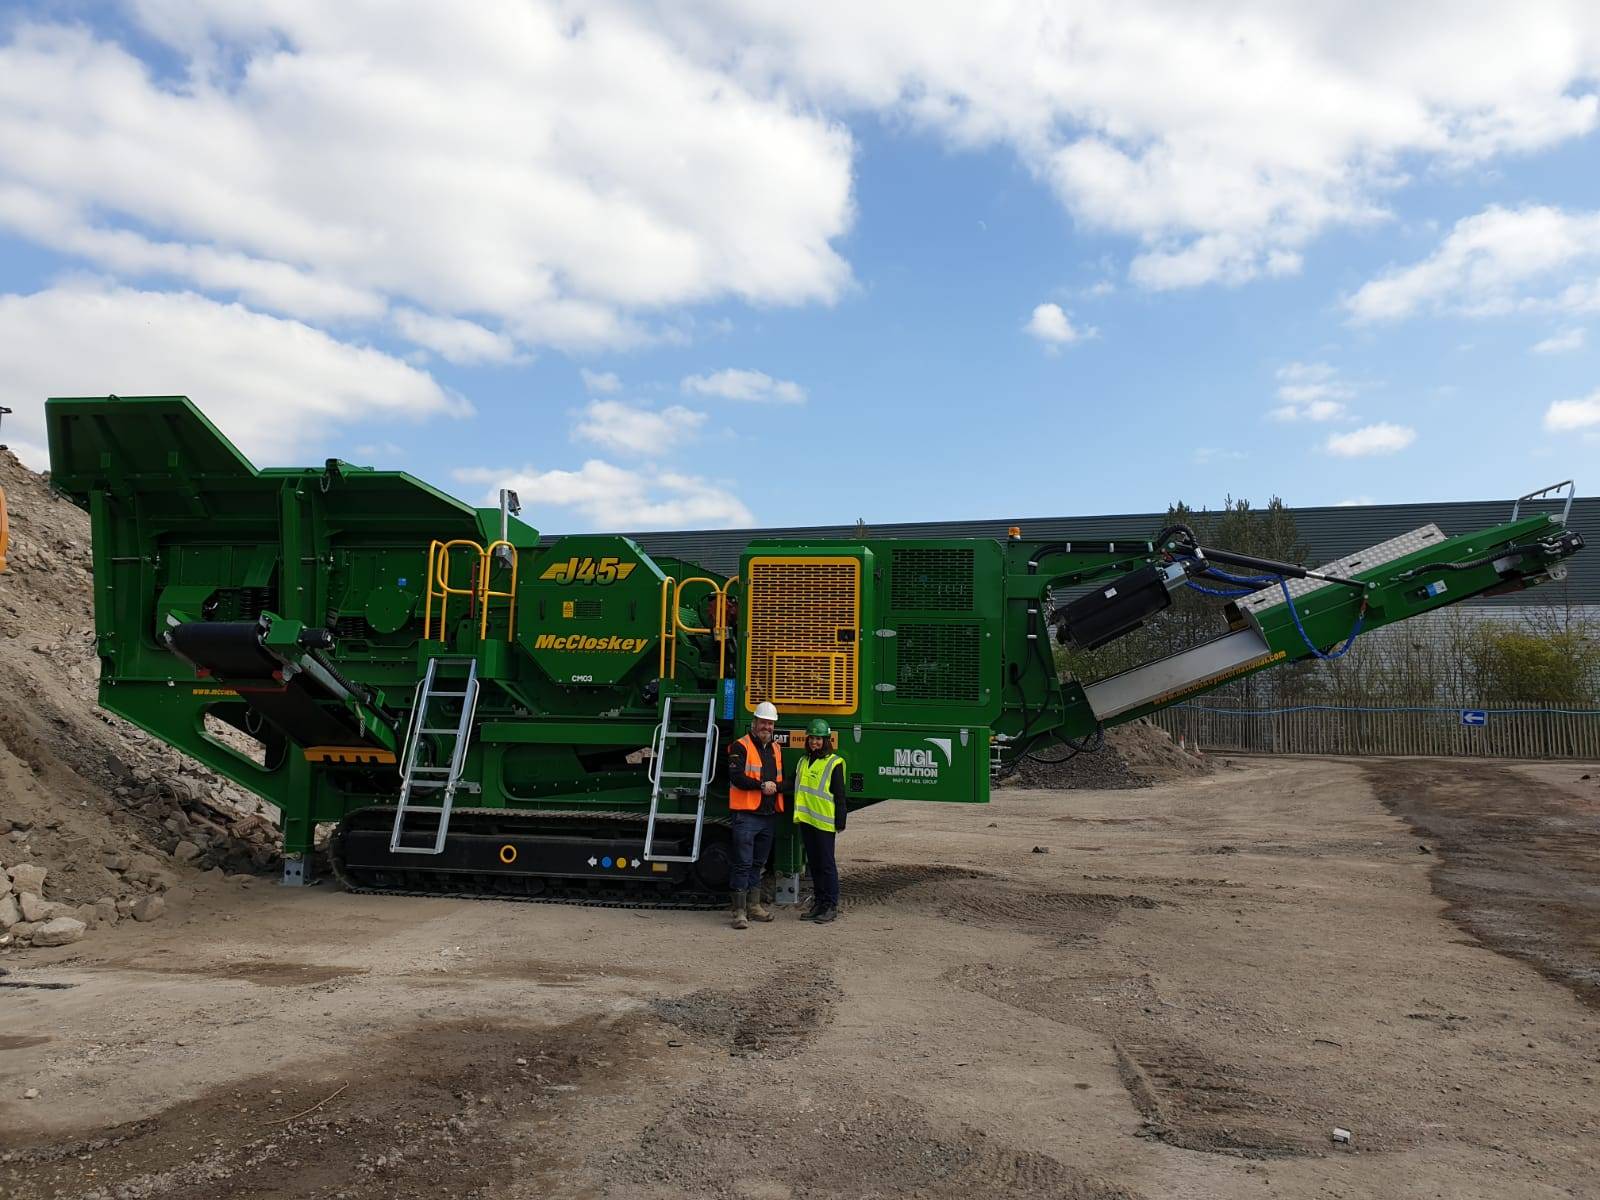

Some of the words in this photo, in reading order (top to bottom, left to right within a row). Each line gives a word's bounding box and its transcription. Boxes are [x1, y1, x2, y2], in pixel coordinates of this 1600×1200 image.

[555, 557, 619, 585] J45
[534, 634, 648, 654] McCloskey
[774, 734, 789, 744] CAT
[893, 748, 938, 768] MGL
[878, 766, 938, 778] DEMOLITION
